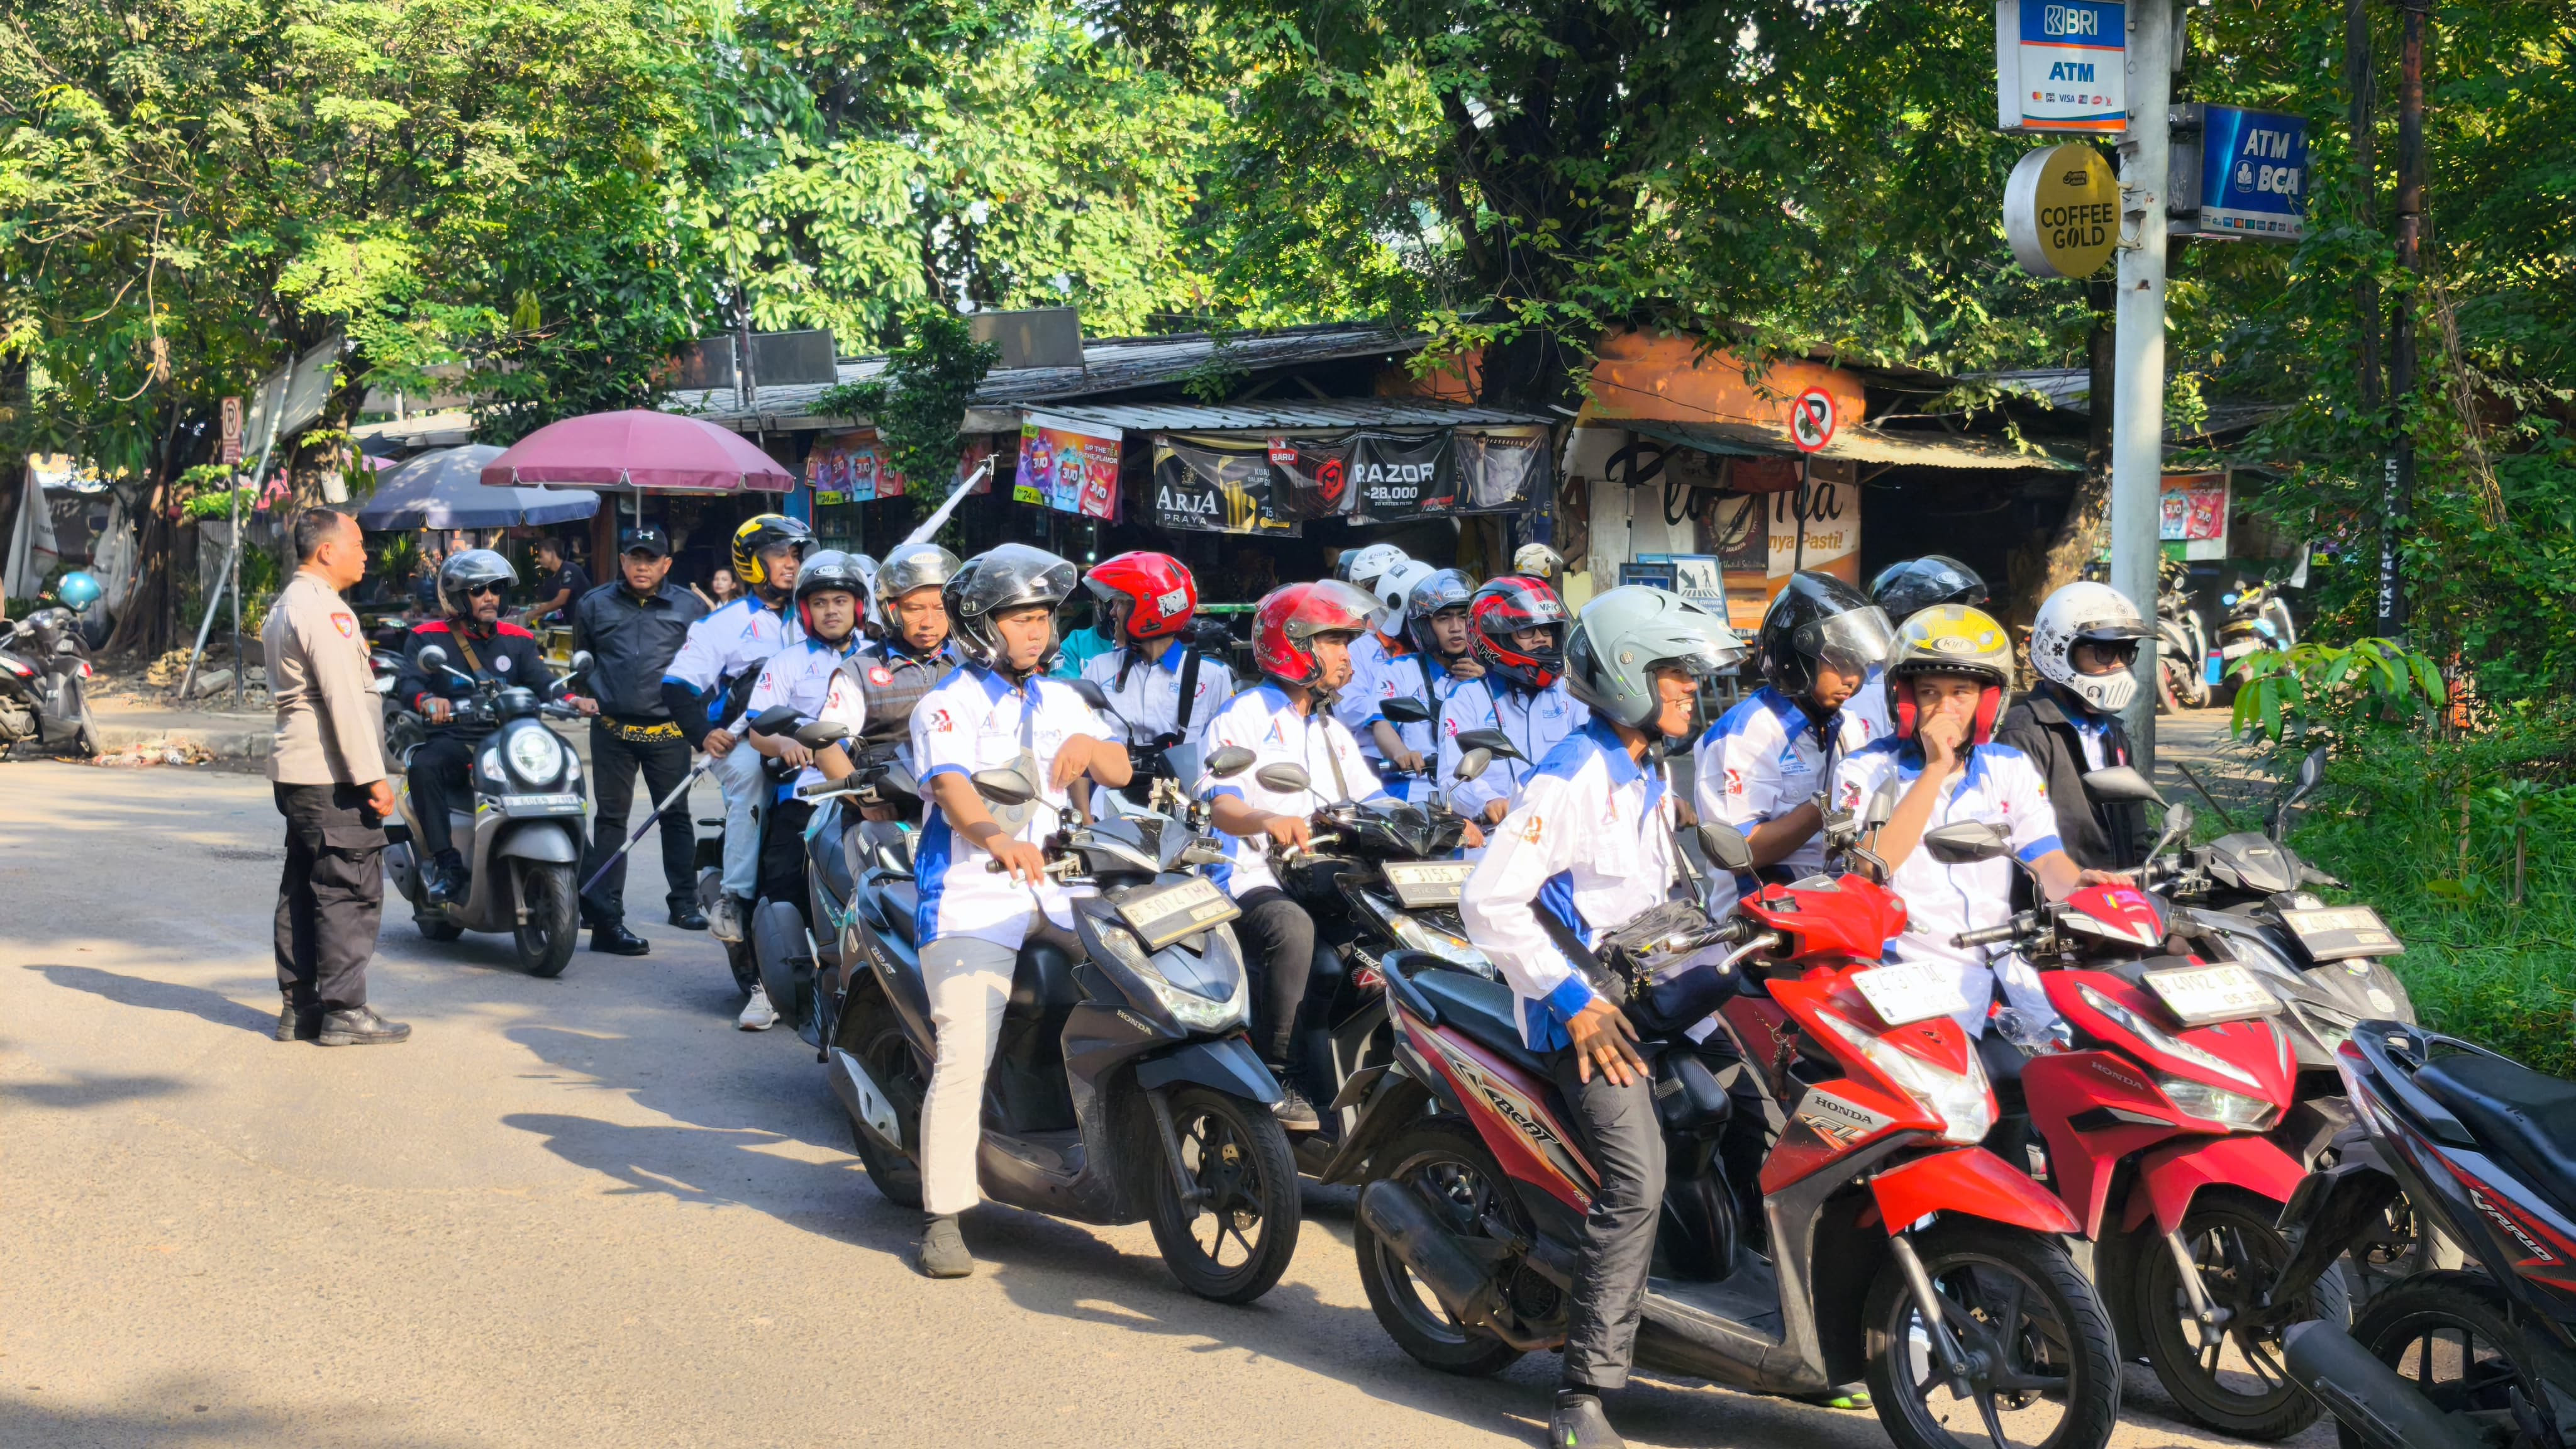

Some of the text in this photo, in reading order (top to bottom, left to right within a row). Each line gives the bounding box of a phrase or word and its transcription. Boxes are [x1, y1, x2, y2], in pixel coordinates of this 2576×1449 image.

[2066, 8, 2098, 36] BRI
[2048, 62, 2094, 82] ATM
[2059, 94, 2075, 103] VISA
[2243, 128, 2290, 159] ATM
[2257, 165, 2299, 195] BCA
[2041, 203, 2113, 228] COFFEE
[2053, 226, 2105, 249] GOLD
[1272, 453, 1295, 461] BARU
[1354, 462, 1435, 483] RAZOR
[1156, 486, 1219, 514] ARJA
[1370, 487, 1419, 499] 28.000
[1164, 513, 1207, 525] PRAYA
[1538, 602, 1558, 612] NHK
[1129, 909, 1144, 923] B
[2153, 978, 2171, 994] B
[1116, 1009, 1152, 1036] HONDA
[2091, 1060, 2144, 1091] HONDA
[1814, 1096, 1872, 1124] HONDA
[2469, 1188, 2553, 1261] VARIO
